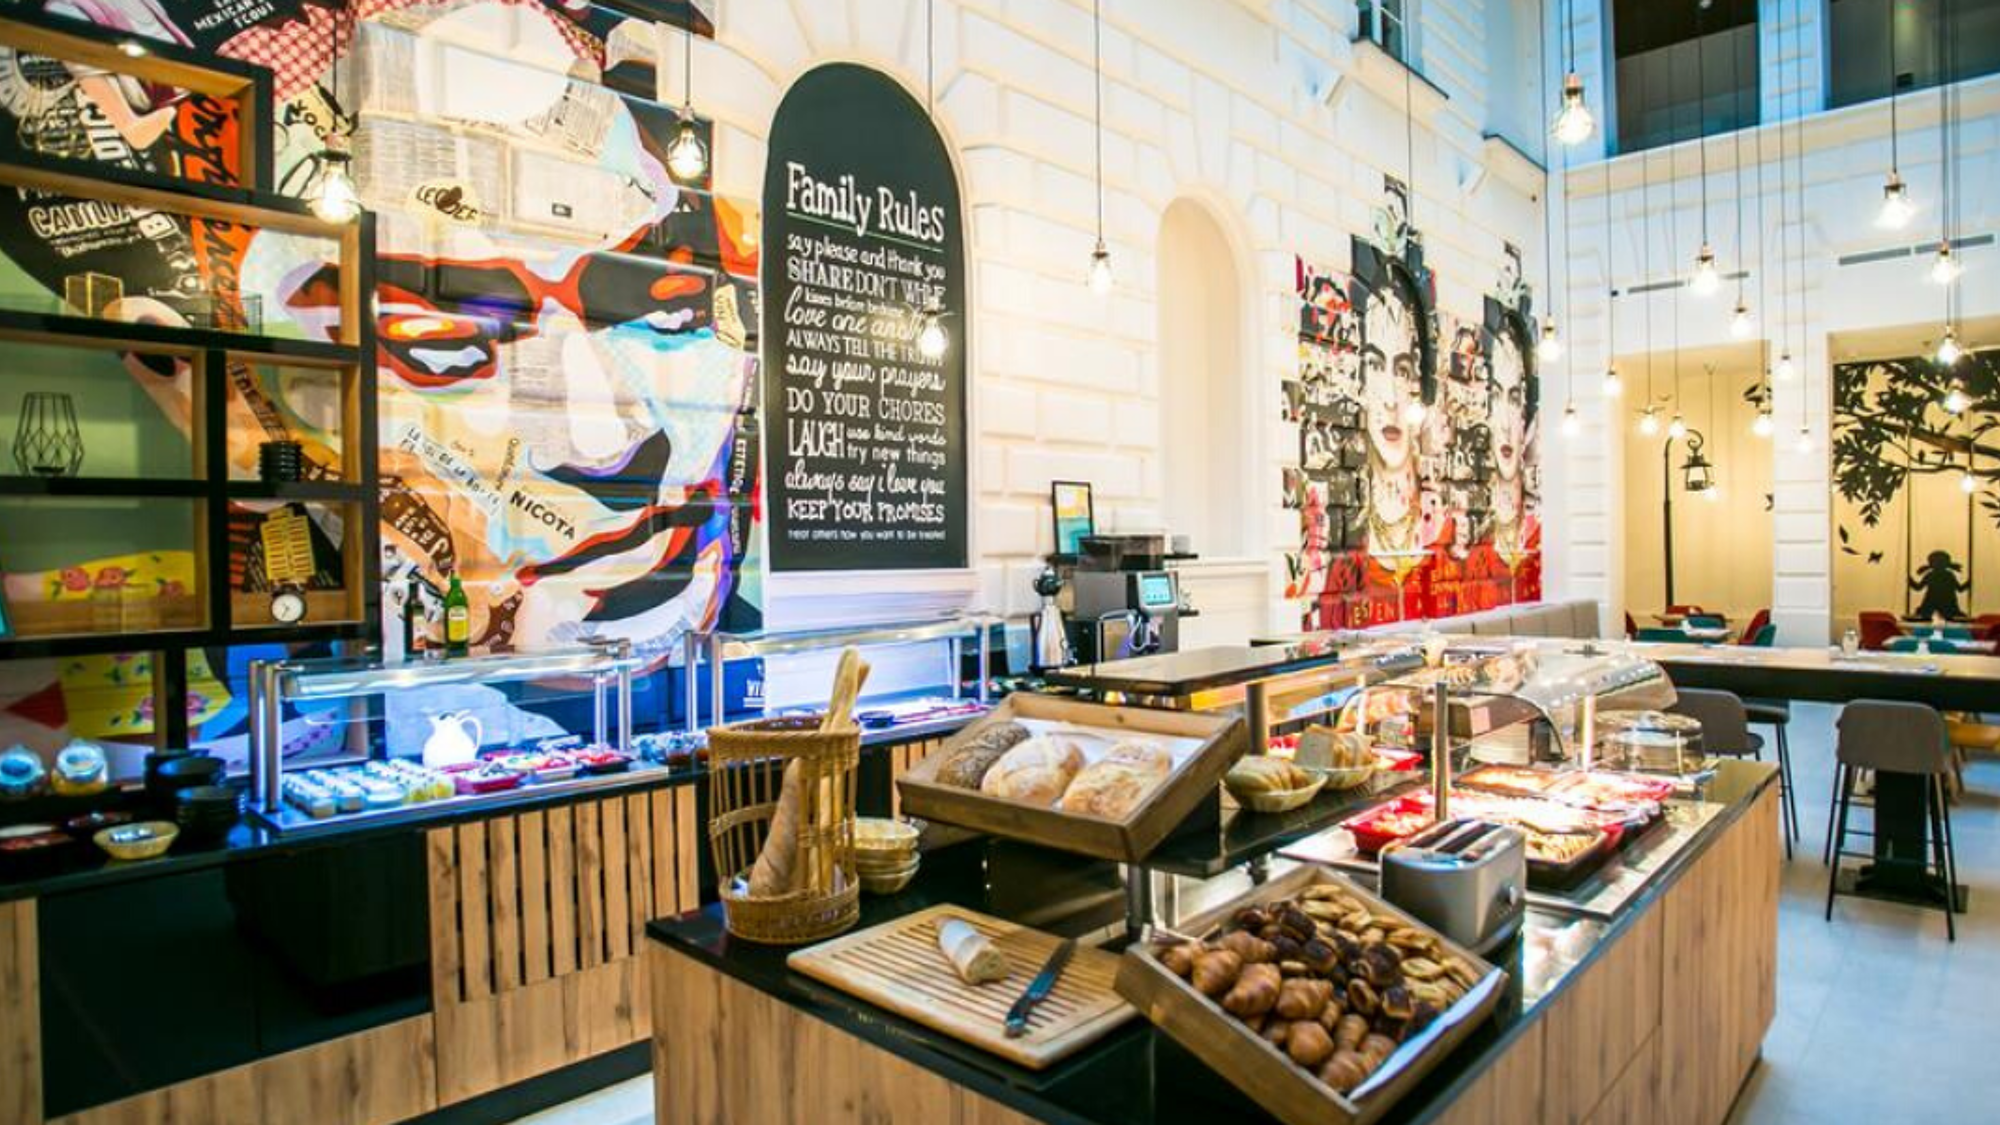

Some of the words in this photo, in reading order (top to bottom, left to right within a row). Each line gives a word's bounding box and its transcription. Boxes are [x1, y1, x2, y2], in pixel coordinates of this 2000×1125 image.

[786, 161, 872, 237] Family
[878, 186, 945, 242] Rules
[787, 256, 853, 292] SHARE
[788, 233, 811, 257] say
[815, 235, 858, 265] please
[860, 246, 886, 270] and
[887, 248, 923, 276] thank
[922, 263, 946, 282] you
[832, 314, 868, 334] one
[786, 329, 841, 354] ALWAYS
[842, 336, 870, 357] TELL
[873, 340, 898, 361] THE
[785, 353, 827, 389] say
[832, 361, 875, 390] your
[879, 366, 946, 400] prayers
[786, 388, 815, 413] DO
[822, 391, 871, 419] YOUR
[878, 397, 946, 426] CHORES
[788, 418, 845, 458] LAUGH
[847, 443, 867, 465] try
[872, 447, 900, 461] new
[907, 443, 946, 470] things
[784, 458, 845, 502] always
[848, 471, 875, 504] say
[510, 490, 576, 541] NICOTA
[787, 498, 827, 521] KEEP
[831, 499, 874, 523] YOUR
[877, 502, 945, 524] PROMISES
